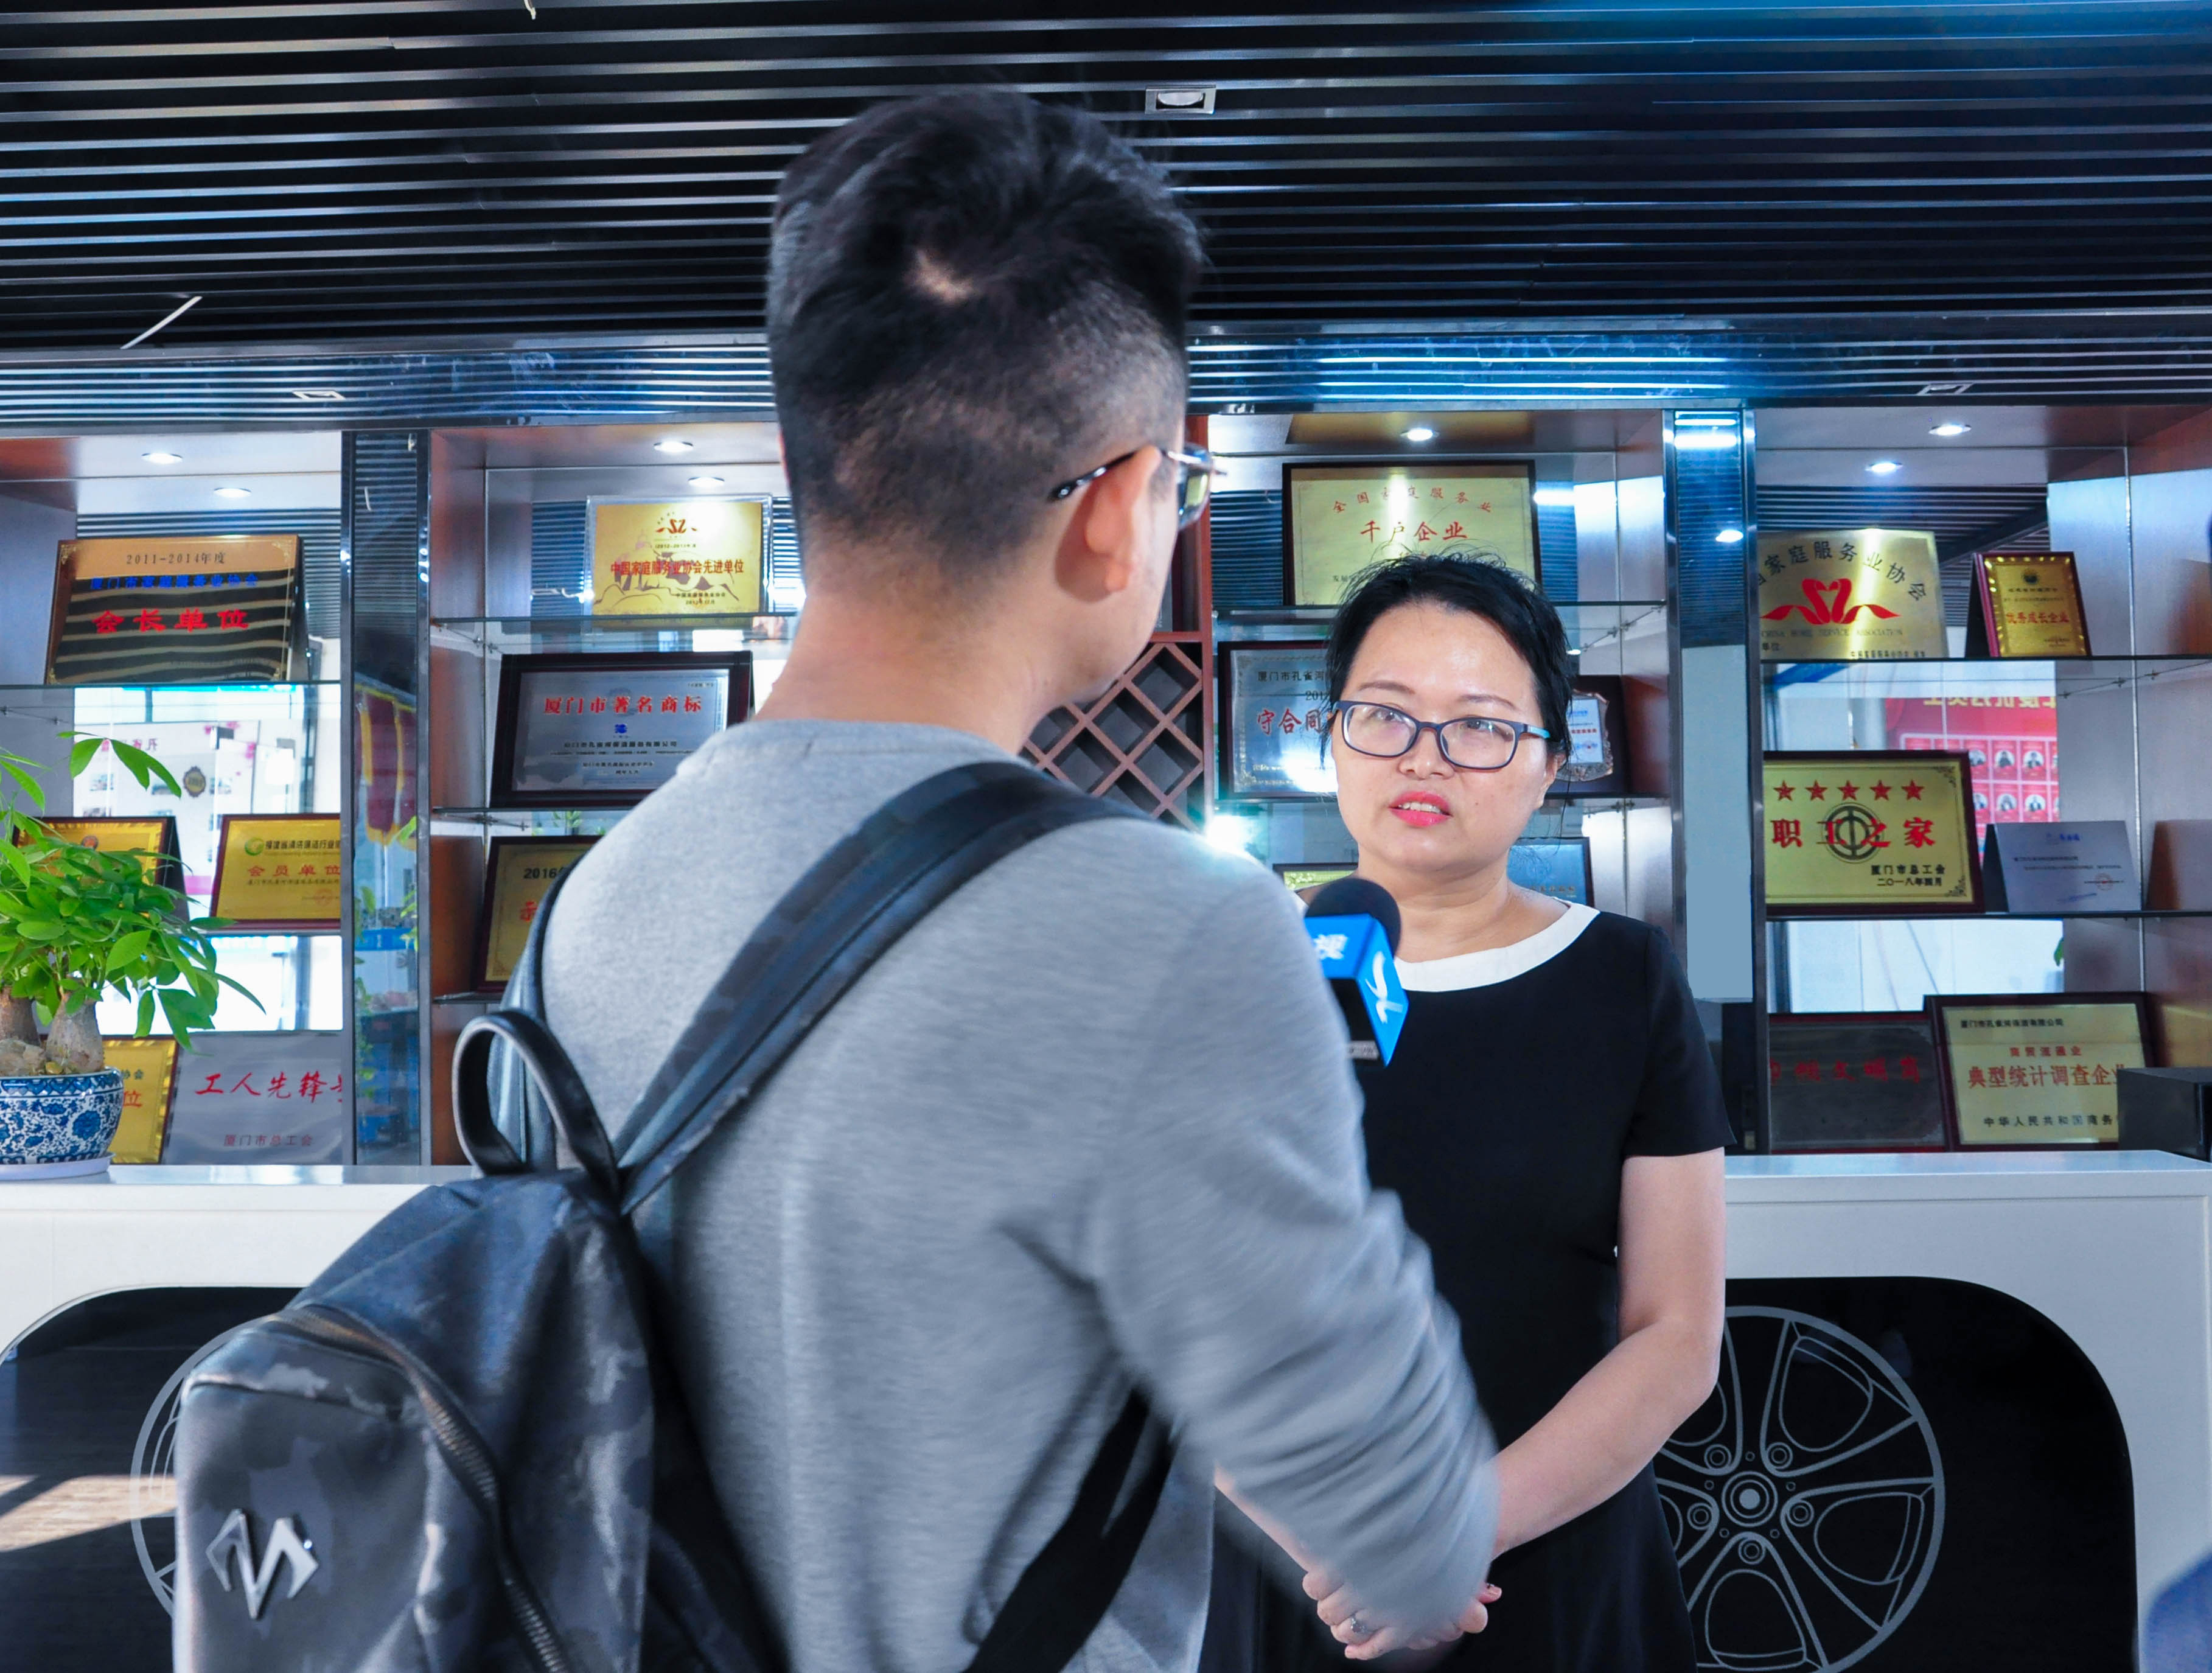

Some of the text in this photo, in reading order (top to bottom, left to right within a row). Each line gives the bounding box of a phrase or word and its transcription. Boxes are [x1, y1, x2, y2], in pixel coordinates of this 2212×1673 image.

[1361, 520, 1467, 543] 千户企业
[126, 552, 225, 565] 2011-2014年度
[610, 559, 744, 576] 中国家庭服务业协会先进单位
[92, 608, 249, 634] 会长单位
[543, 696, 702, 714] 厦门市著名商标
[1771, 817, 1936, 848] 职工之家
[247, 865, 340, 877] 会员单位
[523, 867, 566, 879] 2016
[1871, 864, 1945, 876] 厦门市总工会
[1984, 1114, 2113, 1126] 中华人民共和国商务
[224, 1134, 313, 1147] 厦门市总工会
